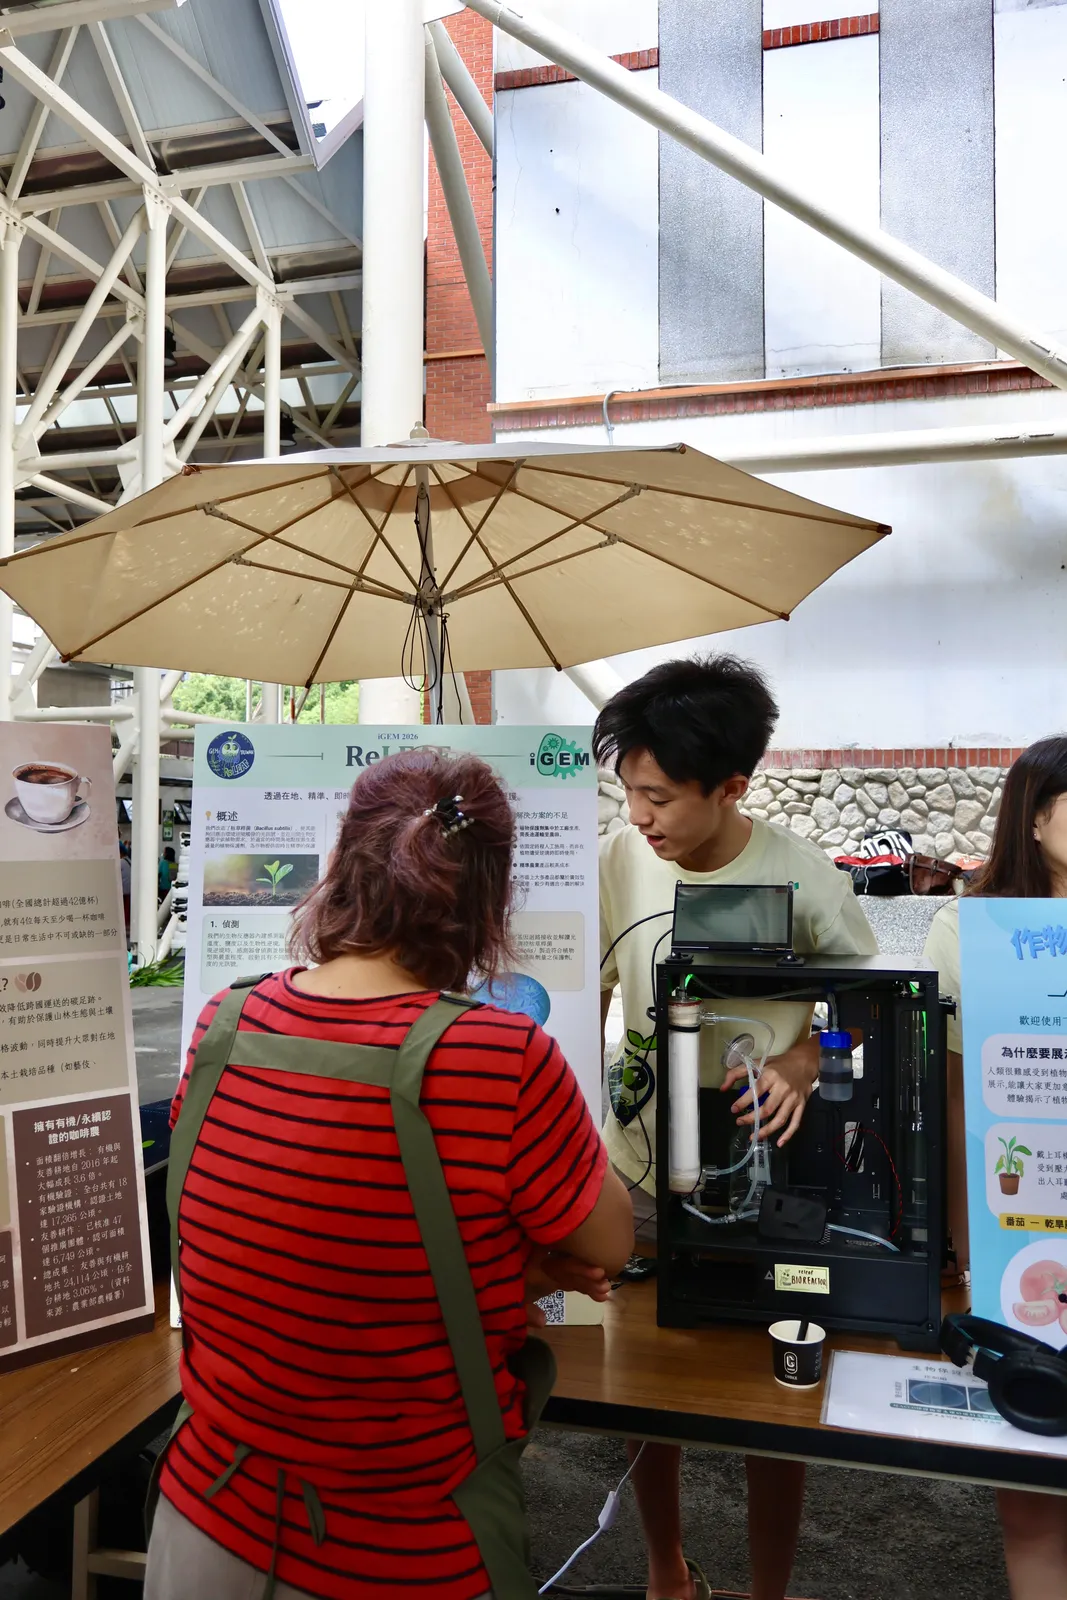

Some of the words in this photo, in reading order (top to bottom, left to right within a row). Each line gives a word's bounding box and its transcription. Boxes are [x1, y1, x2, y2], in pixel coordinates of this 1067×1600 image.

[530, 752, 590, 766] iGEM
[216, 811, 238, 822] 概述
[0, 896, 99, 910] 啡(全國總計超過42億杯)
[222, 919, 240, 929] 偵測
[48, 1126, 100, 1145] 證的咖啡農
[1006, 1216, 1025, 1227] 番茄
